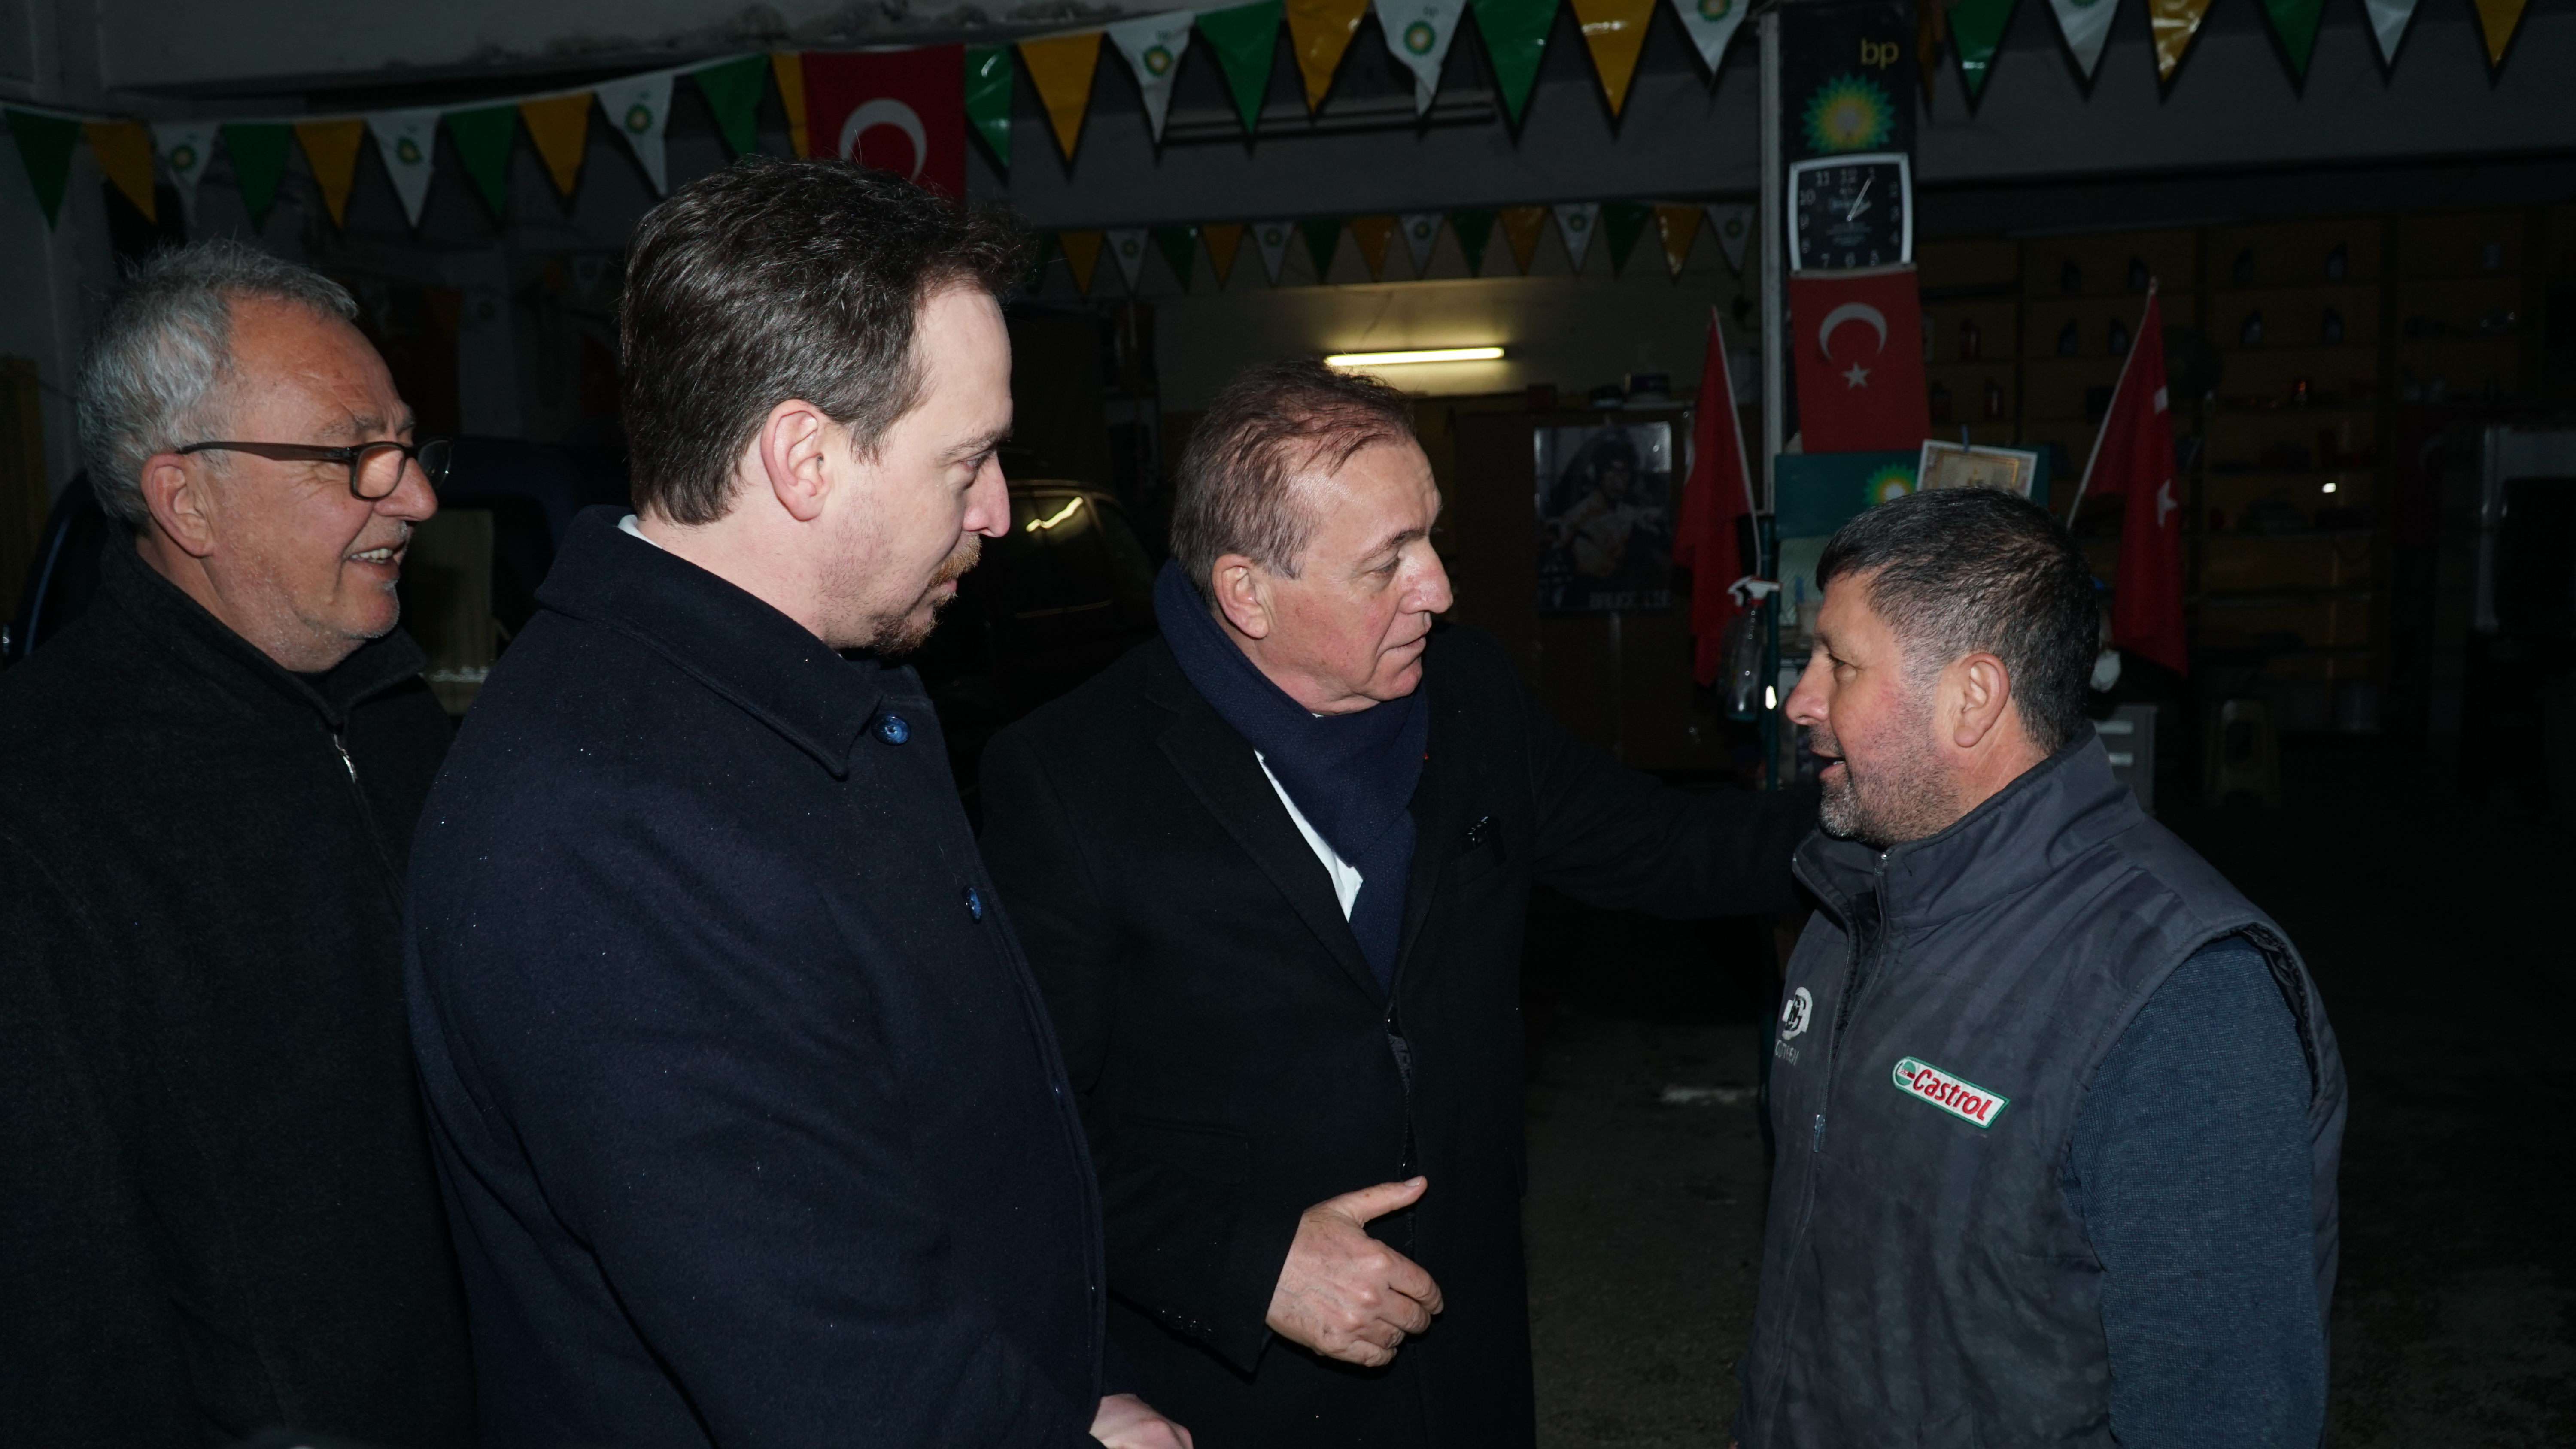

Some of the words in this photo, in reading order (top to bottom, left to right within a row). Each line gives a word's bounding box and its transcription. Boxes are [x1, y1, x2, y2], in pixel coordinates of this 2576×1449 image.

[1861, 37, 1899, 70] bp
[1816, 171, 1830, 187] 11
[1799, 188, 1816, 206] 10
[1821, 253, 1830, 268] 7
[1913, 1069, 1993, 1121] Castrol
